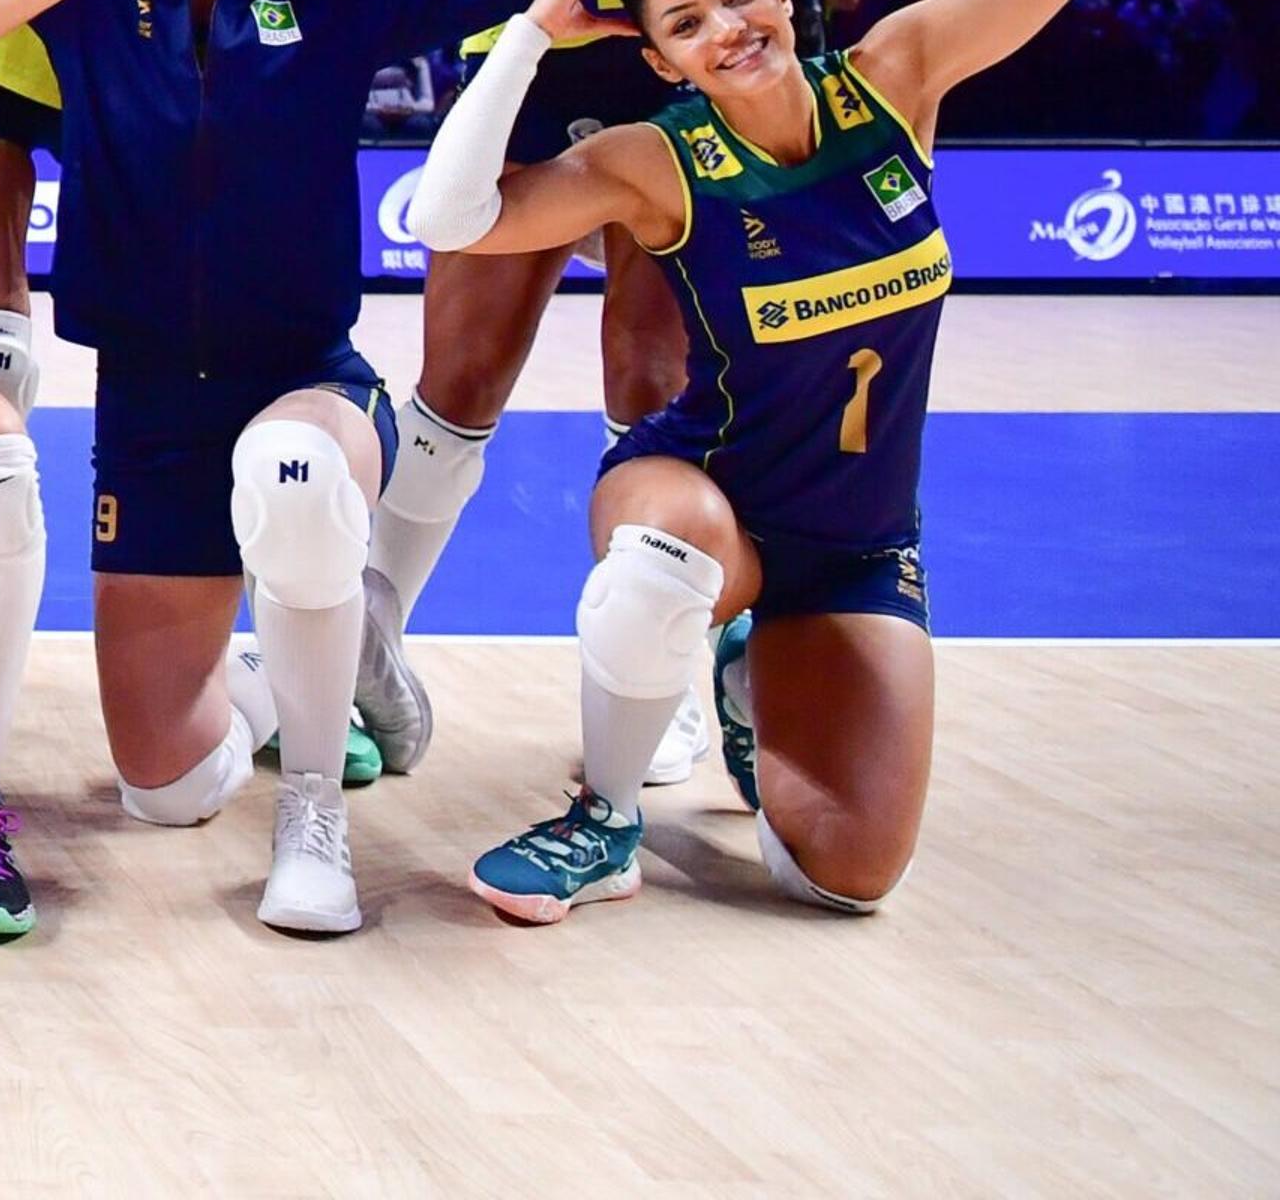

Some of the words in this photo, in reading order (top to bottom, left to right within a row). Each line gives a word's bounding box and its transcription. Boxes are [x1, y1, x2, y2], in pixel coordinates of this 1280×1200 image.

[887, 190, 926, 220] BRASIL
[794, 287, 871, 321] BANCO
[874, 279, 903, 301] DO
[839, 347, 884, 454] 1
[278, 459, 310, 484] N1
[95, 494, 118, 543] 9
